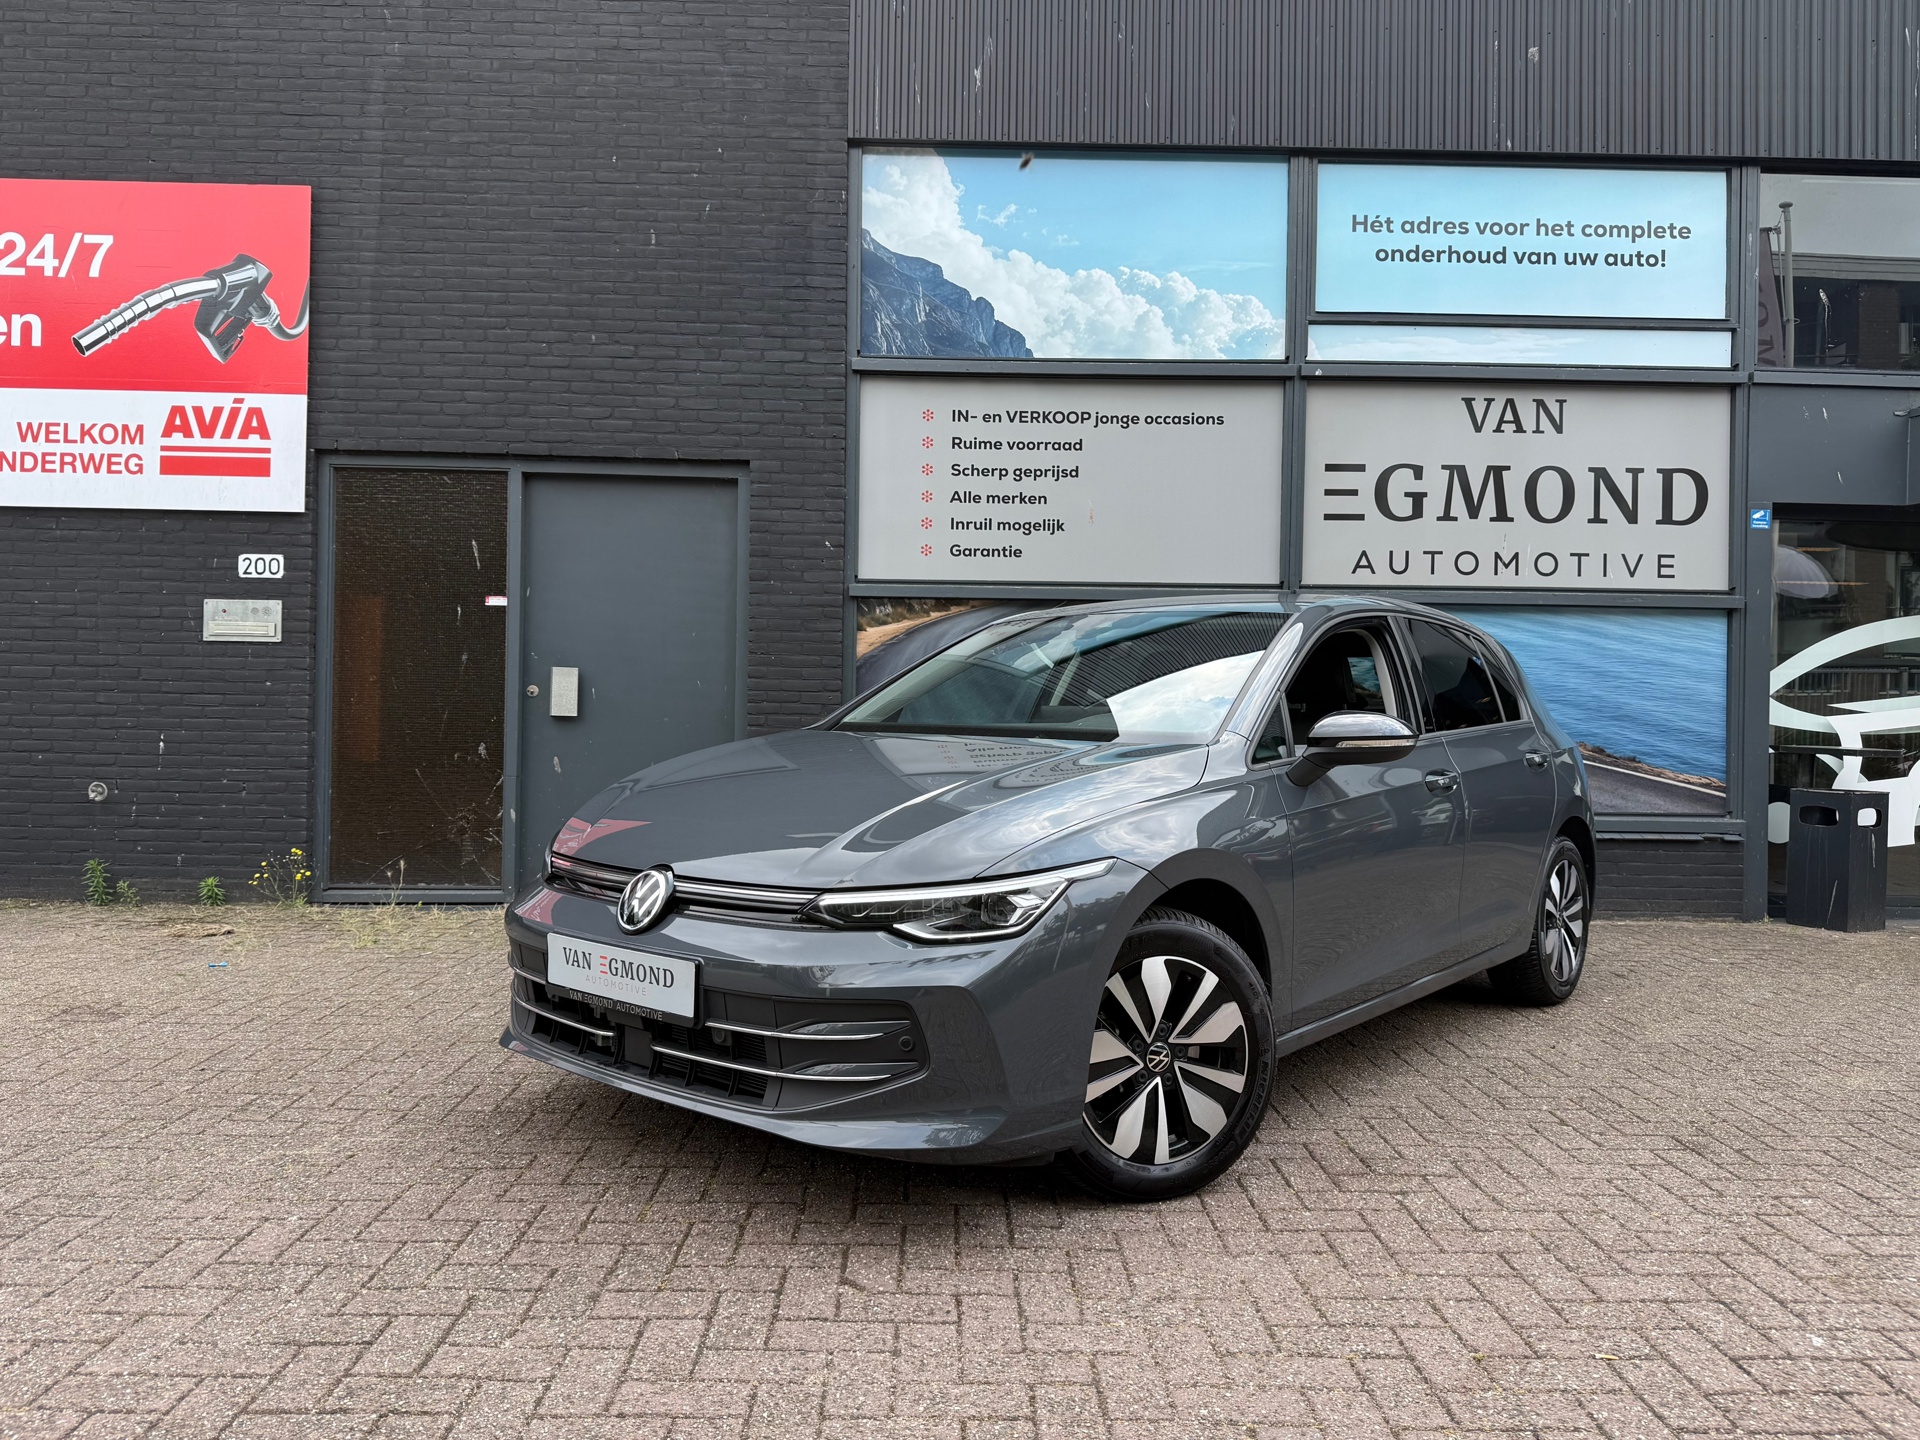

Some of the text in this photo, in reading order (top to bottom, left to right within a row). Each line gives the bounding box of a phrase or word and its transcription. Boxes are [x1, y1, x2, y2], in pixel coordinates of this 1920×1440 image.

[1351, 214, 1692, 243] Hét adres voor het complete
[0, 231, 114, 278] 24/7
[1375, 244, 1667, 268] onderhoud van uw auto!
[0, 312, 42, 347] n
[951, 409, 1225, 429] IN- en VERKOOP jonge occasions
[1460, 396, 1568, 435] VAN
[16, 421, 144, 445] WELKOM
[951, 436, 1083, 452] Ruime voorraad
[950, 463, 1079, 482] Scherp geprijsd
[949, 490, 1048, 506] Alle merken
[1323, 462, 1710, 527] EGMOND
[950, 517, 1065, 536] Inruil mogelijk
[949, 543, 1023, 558] Garantie
[242, 557, 281, 576] 200
[1350, 549, 1677, 580] AUTOMOTIVE
[562, 946, 675, 988] VAN EGMOND
[585, 974, 647, 996] AUTOMOTIVE
[569, 990, 663, 1021] VAN EGMOND AUTOMOTIVE
